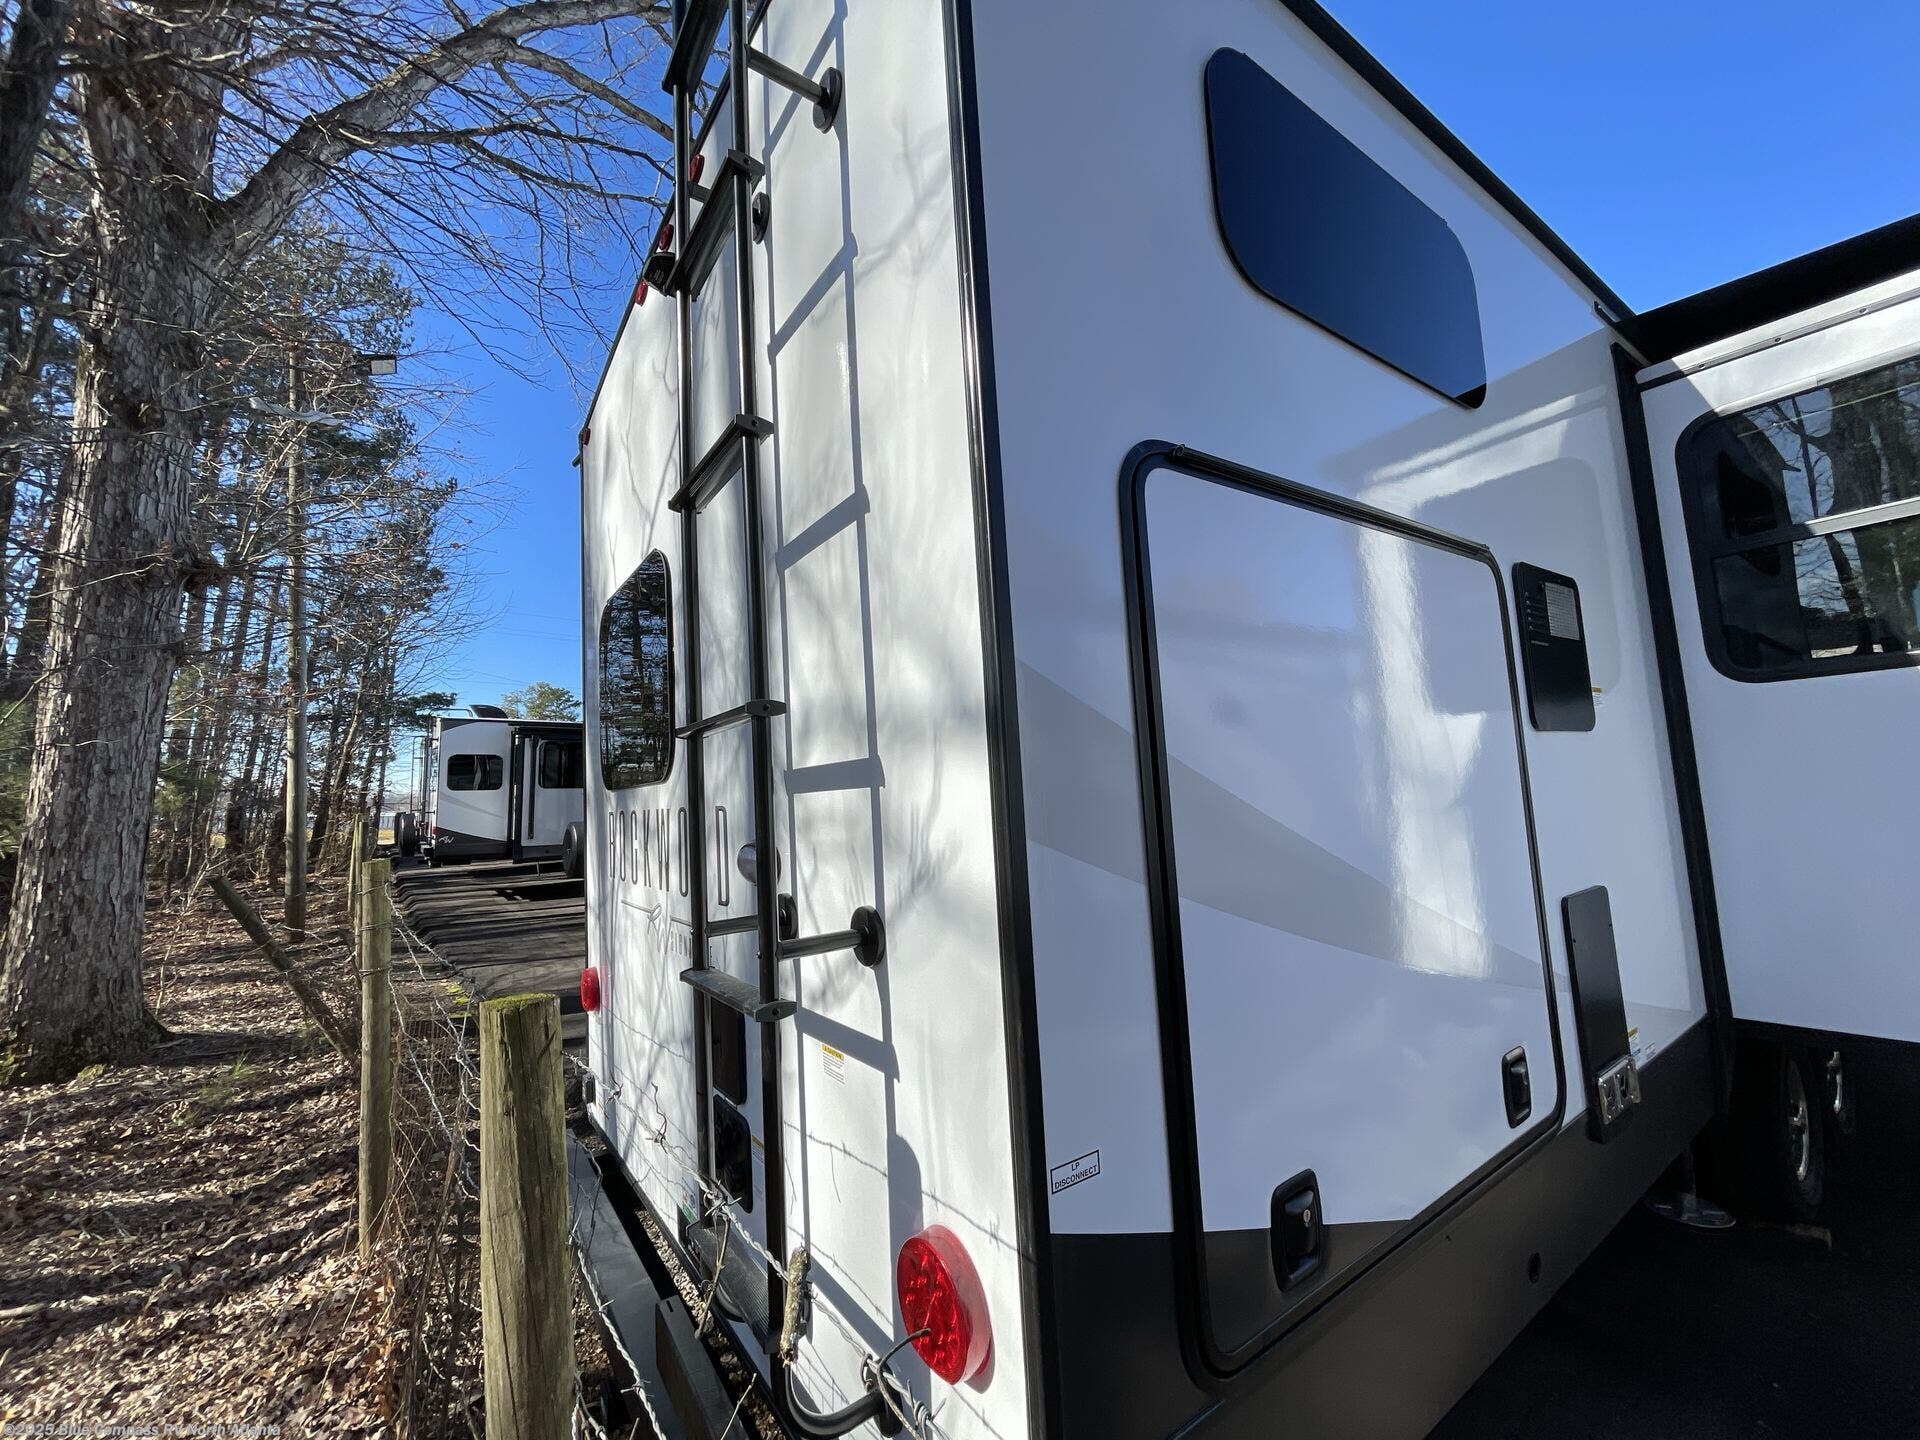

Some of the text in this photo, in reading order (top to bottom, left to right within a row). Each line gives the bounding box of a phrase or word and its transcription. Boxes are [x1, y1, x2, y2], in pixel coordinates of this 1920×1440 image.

[609, 807, 729, 906] ROCKWOD
[1054, 1165, 1097, 1190] DISCONNECT
[1071, 1162, 1080, 1172] LP
